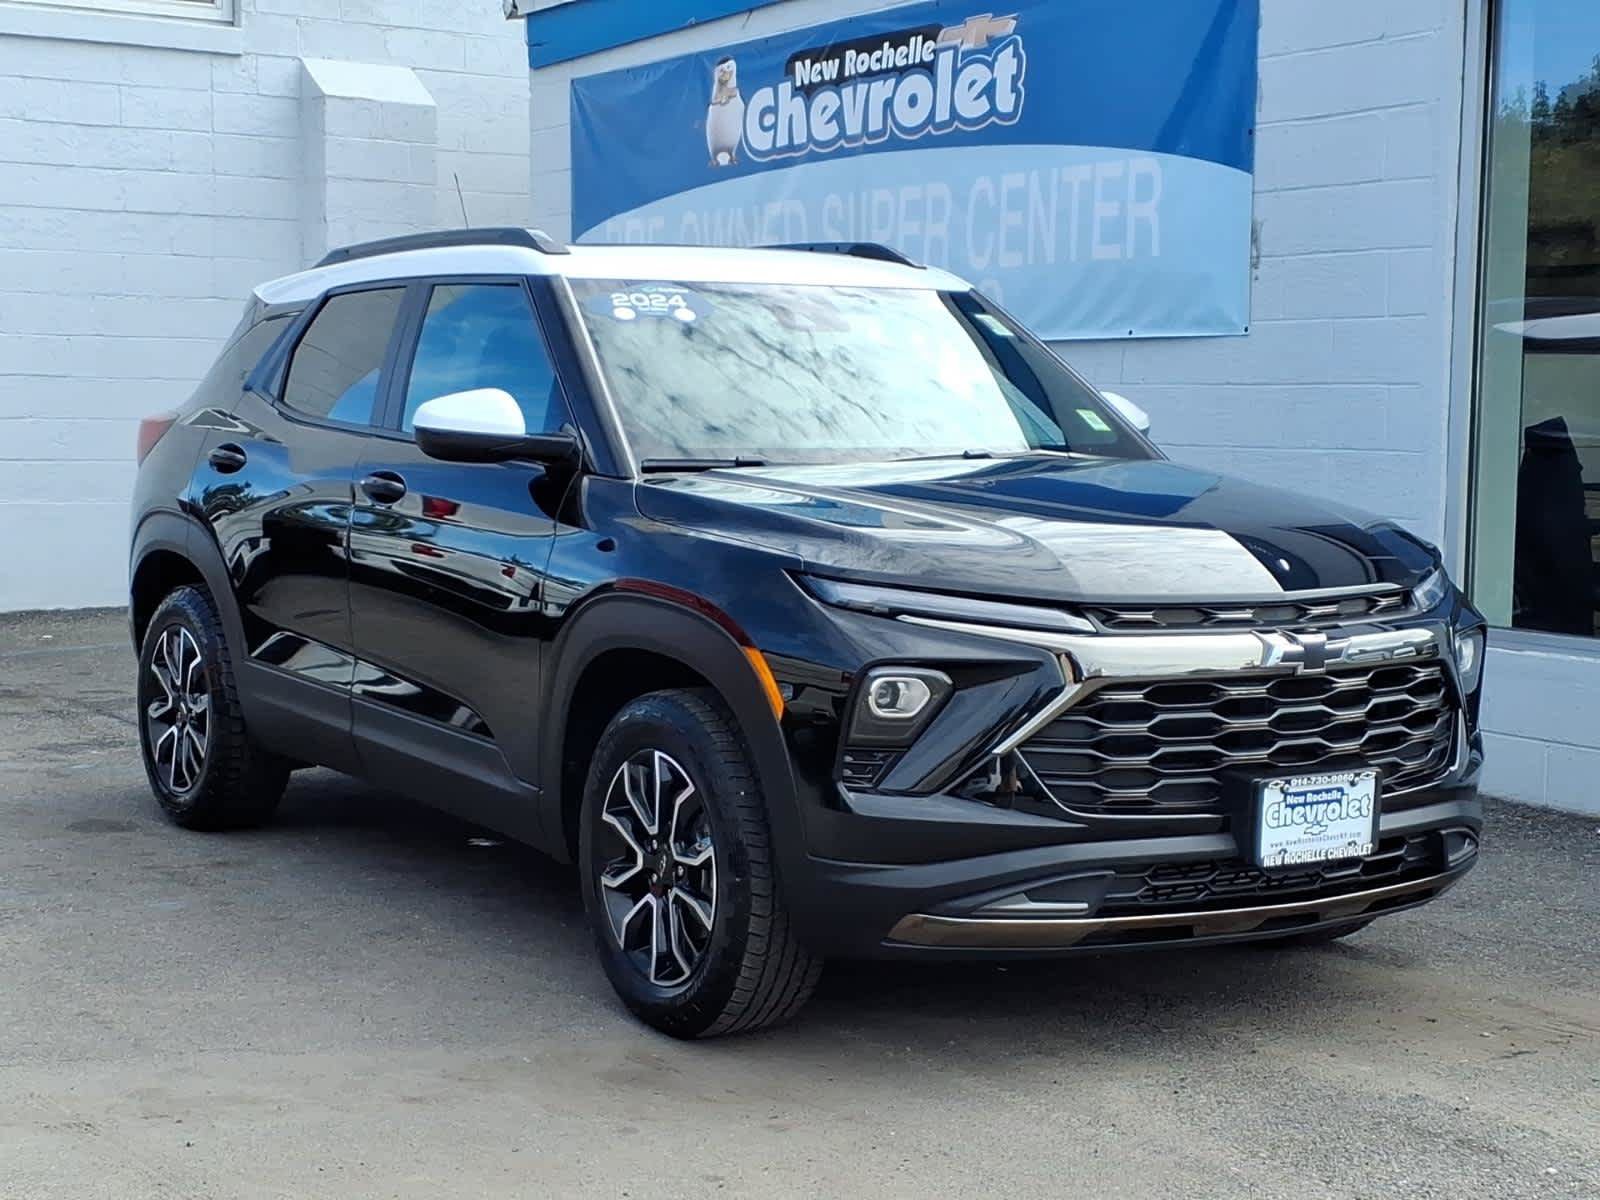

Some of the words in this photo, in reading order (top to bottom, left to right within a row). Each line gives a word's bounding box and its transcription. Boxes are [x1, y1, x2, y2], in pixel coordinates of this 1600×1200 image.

[794, 58, 840, 88] New
[844, 34, 936, 78] Rochelle
[746, 44, 1019, 152] Chevrolet
[965, 156, 1163, 271] CENTER
[609, 292, 688, 308] 2024
[1265, 793, 1371, 829] Chevrolet
[1286, 794, 1306, 806] New
[1306, 790, 1342, 803] Rochelle
[1263, 853, 1283, 867] NEW
[1284, 848, 1327, 865] ROCHELLE
[1327, 842, 1373, 860] CHEVROLET
